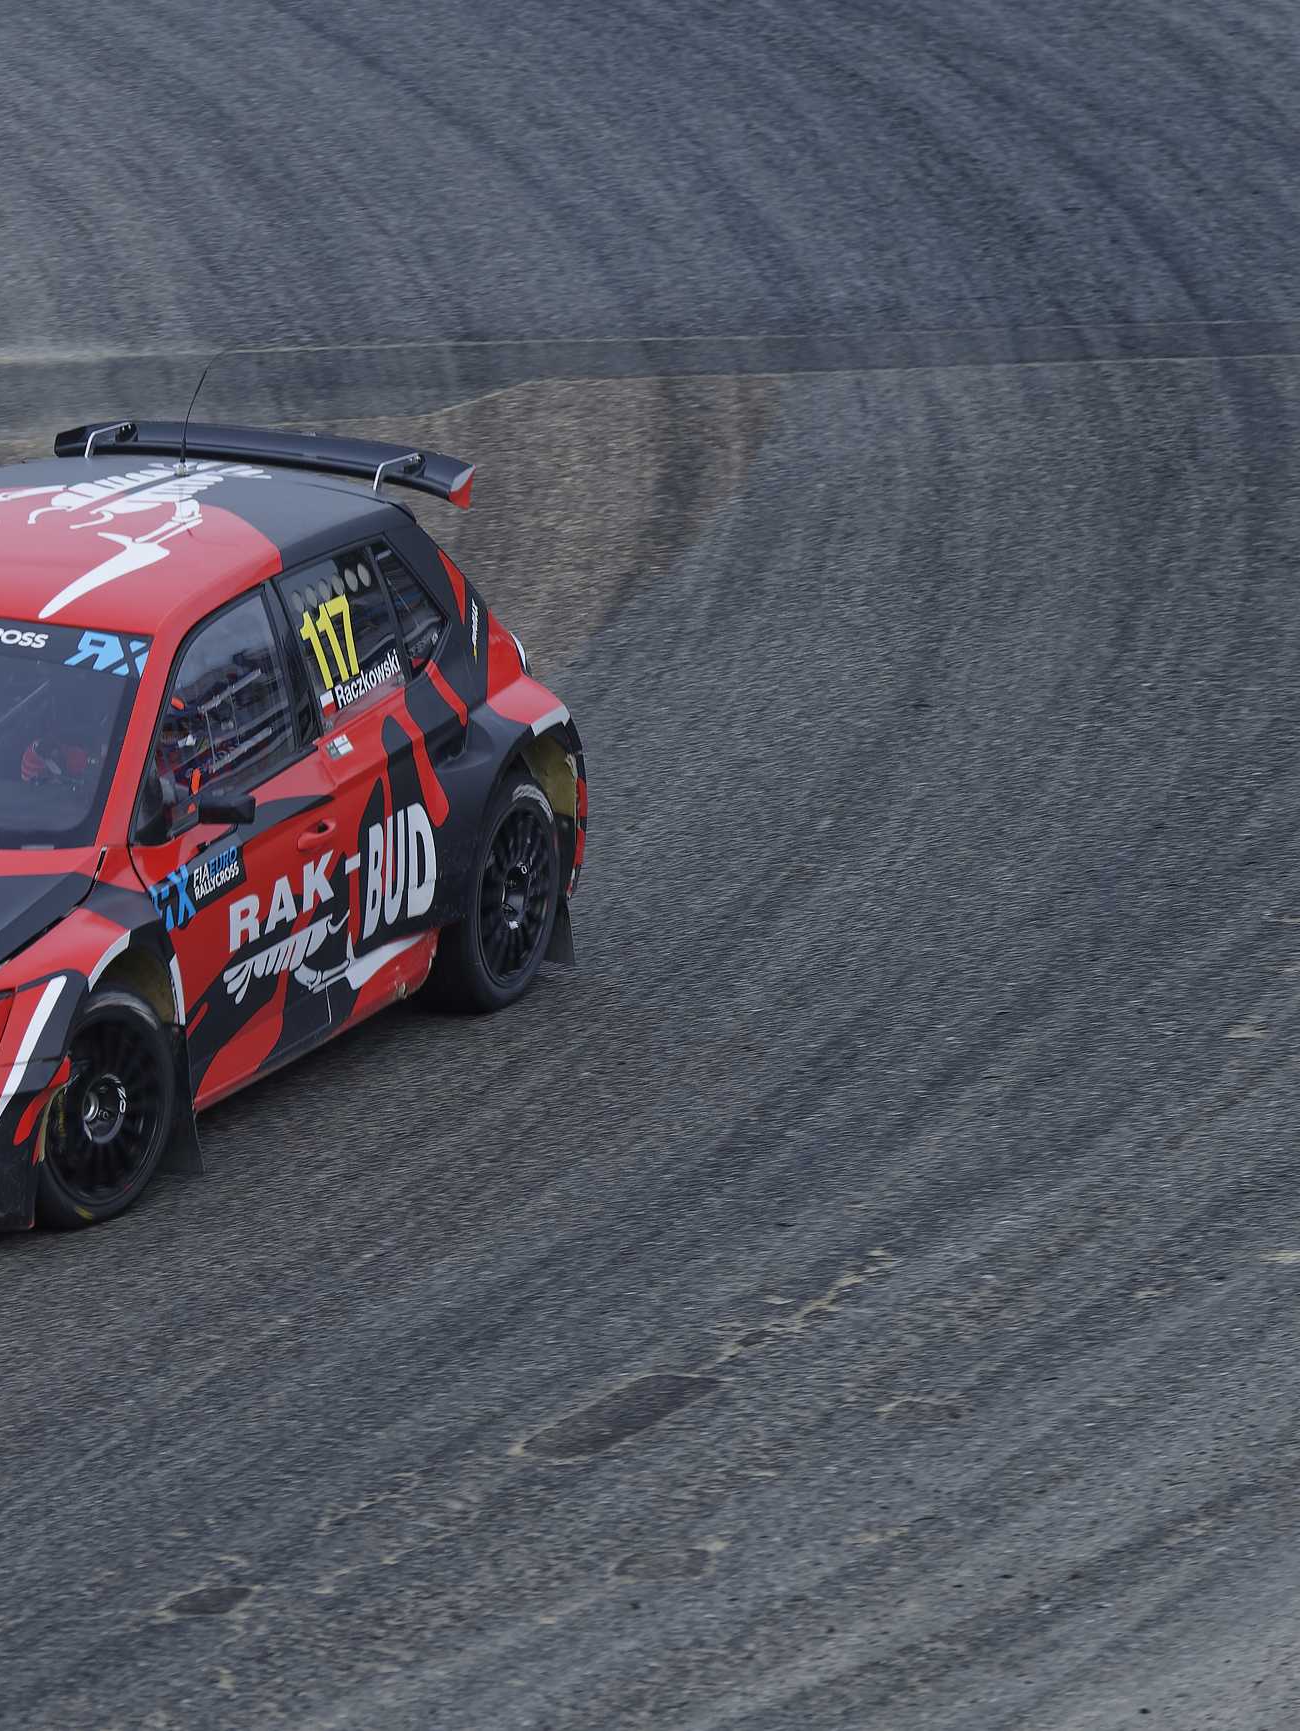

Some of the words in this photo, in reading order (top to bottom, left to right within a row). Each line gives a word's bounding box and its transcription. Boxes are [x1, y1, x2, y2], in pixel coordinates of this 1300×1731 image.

[300, 593, 360, 690] 117
[334, 648, 401, 709] Raczkowski
[193, 862, 210, 888] FIA
[209, 846, 238, 876] EURO
[194, 861, 240, 901] RALLYCROSS
